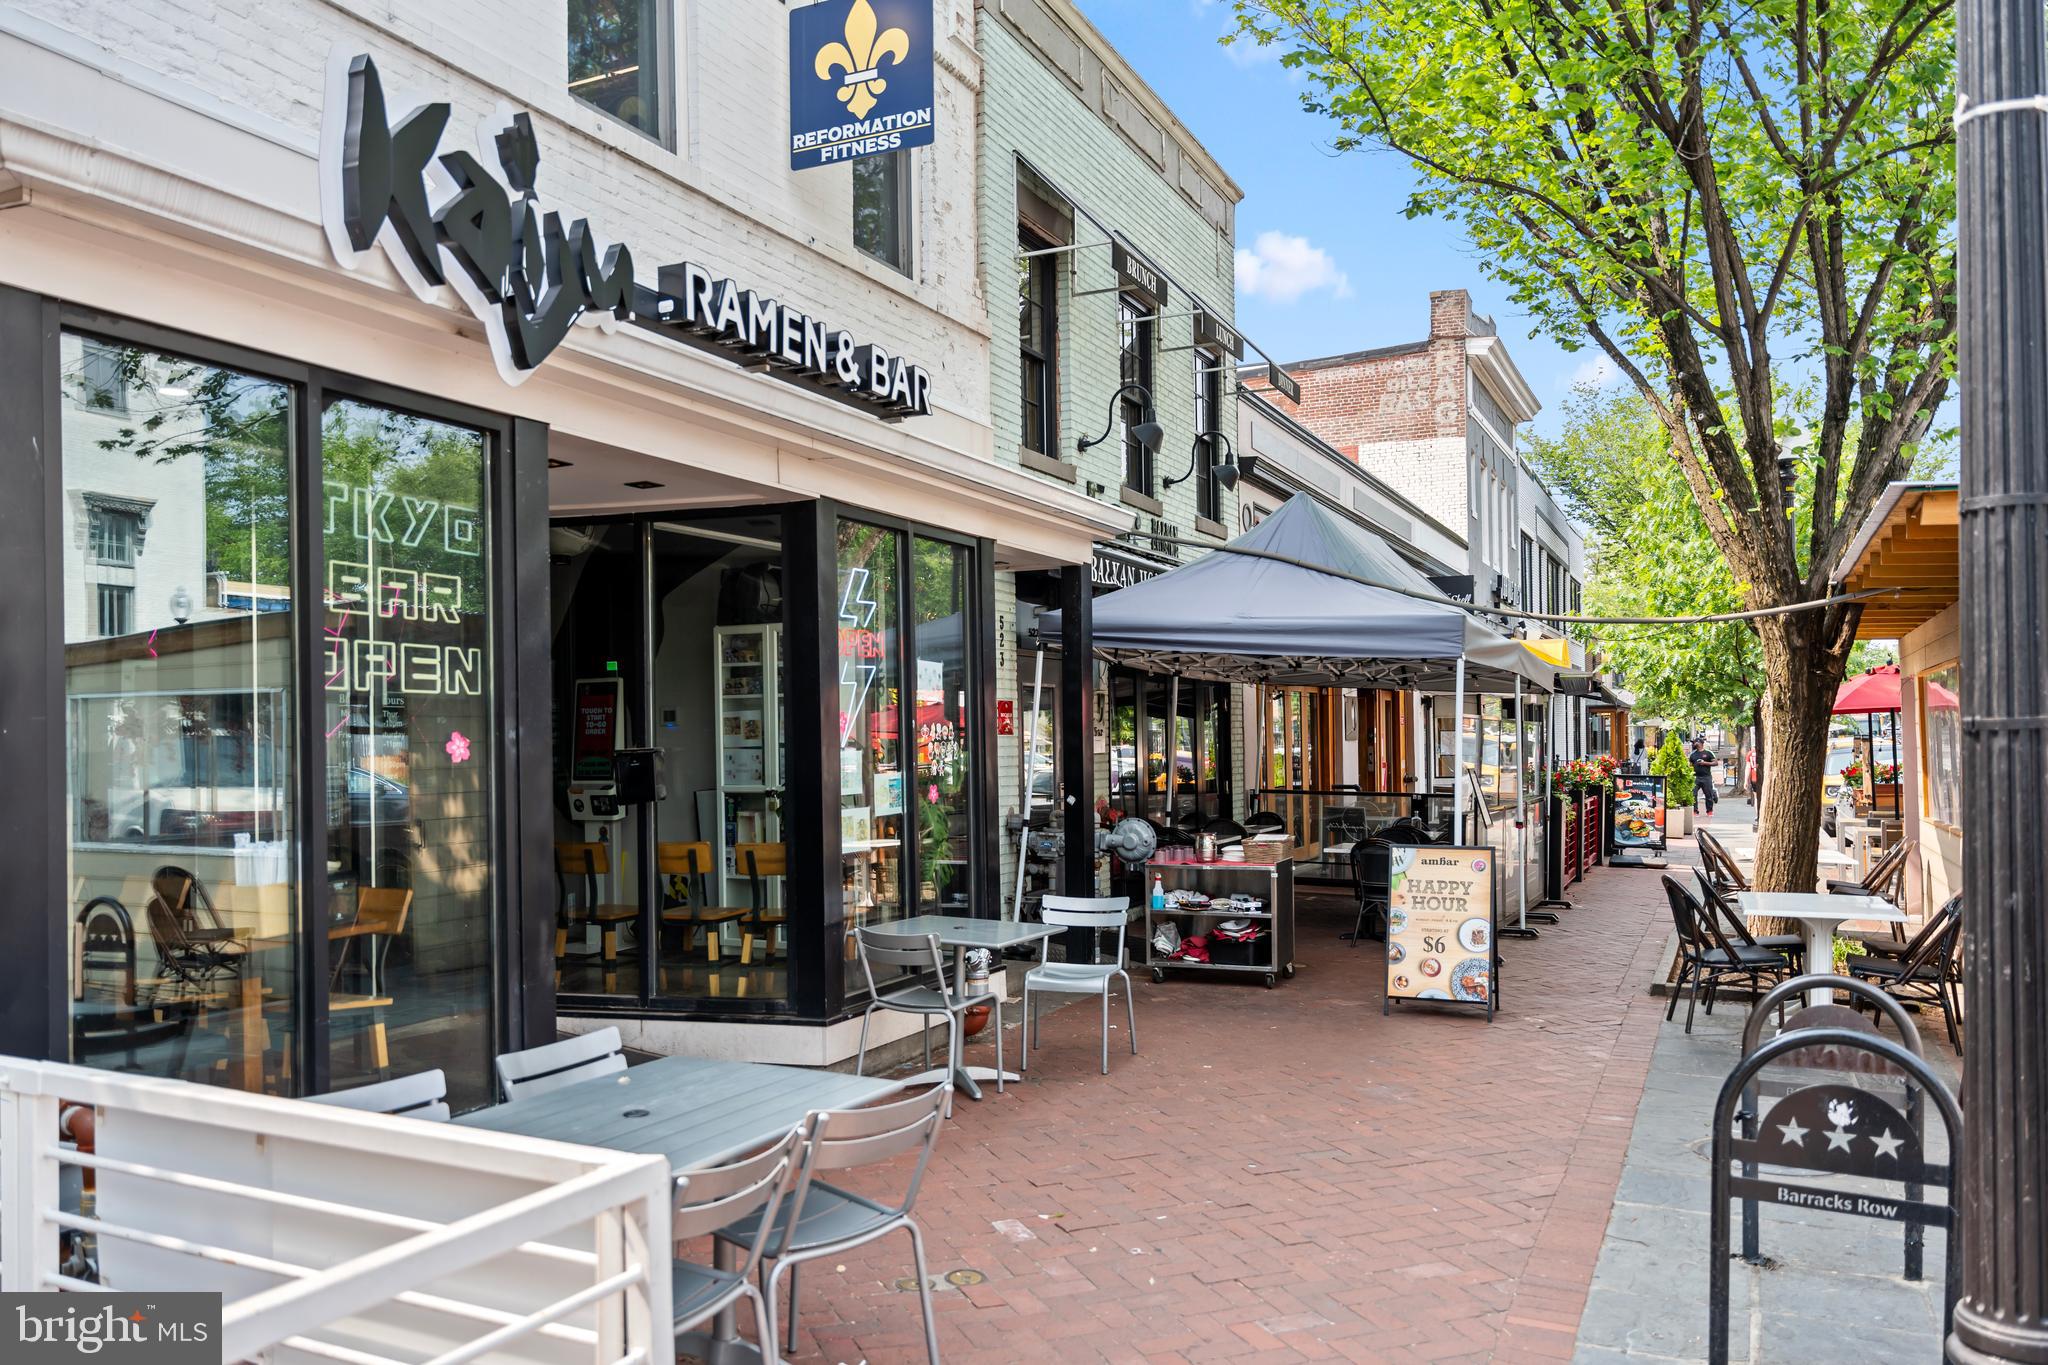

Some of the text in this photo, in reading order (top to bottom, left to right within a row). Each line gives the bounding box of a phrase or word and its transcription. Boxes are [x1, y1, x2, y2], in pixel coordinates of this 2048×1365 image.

[792, 107, 932, 149] REFORMATION
[820, 132, 902, 162] FITNESS
[1126, 255, 1157, 294] BRUNCH
[684, 260, 827, 374] RAMEN
[834, 329, 861, 386] &
[870, 343, 933, 416] BAR
[1215, 323, 1234, 350] LUNCH
[1091, 555, 1136, 588] BALKAN
[328, 559, 462, 624] BAR
[1421, 856, 1460, 866] ambar
[1407, 878, 1474, 896] HAPPY
[1411, 895, 1468, 912] HOUR
[1422, 934, 1447, 954] $6
[1777, 1186, 1898, 1218] Barracks Row
